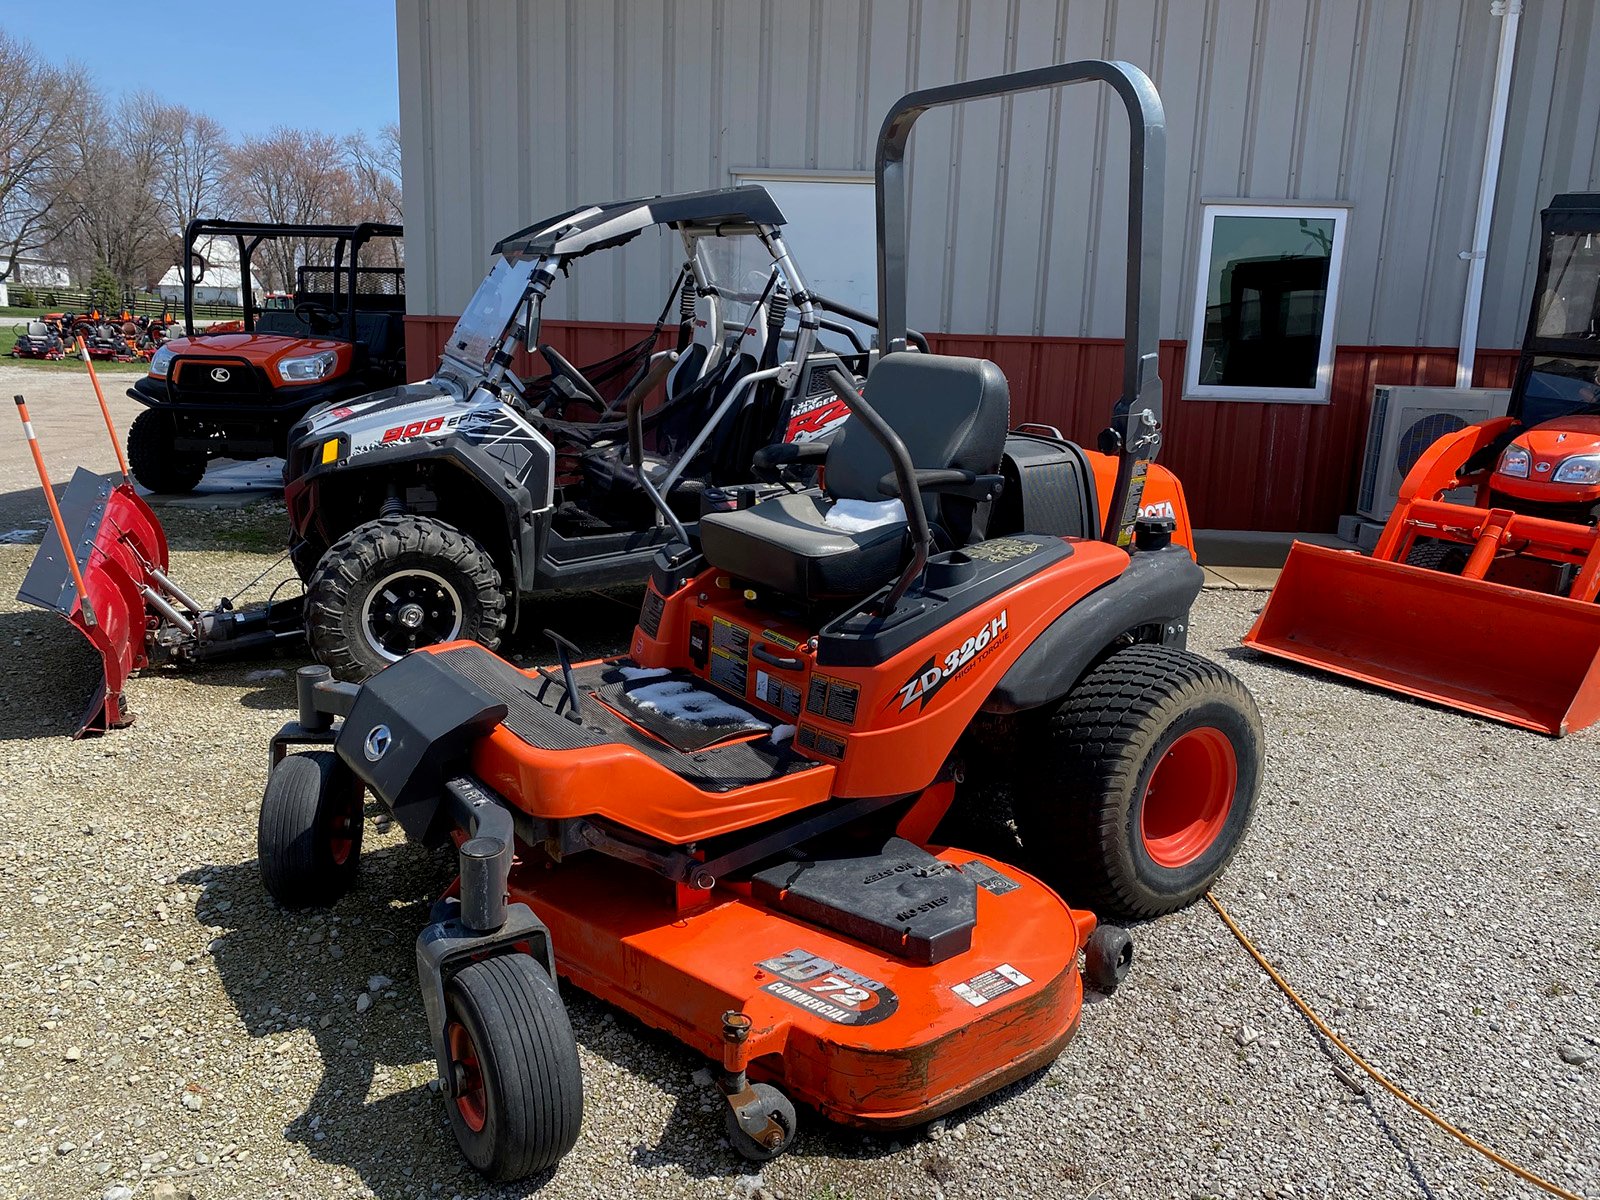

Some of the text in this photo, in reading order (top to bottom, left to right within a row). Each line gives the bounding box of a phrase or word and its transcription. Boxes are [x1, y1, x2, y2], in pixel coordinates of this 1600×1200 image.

[791, 395, 838, 417] RANGER
[382, 413, 474, 443] 900 EFI
[954, 631, 1010, 682] HIGH TORQUE
[863, 862, 914, 885] NO STEP
[896, 896, 949, 922] NO STEP
[754, 948, 836, 983] ZD
[767, 982, 851, 1022] COMMERCIAL
[809, 976, 870, 1007] 72
